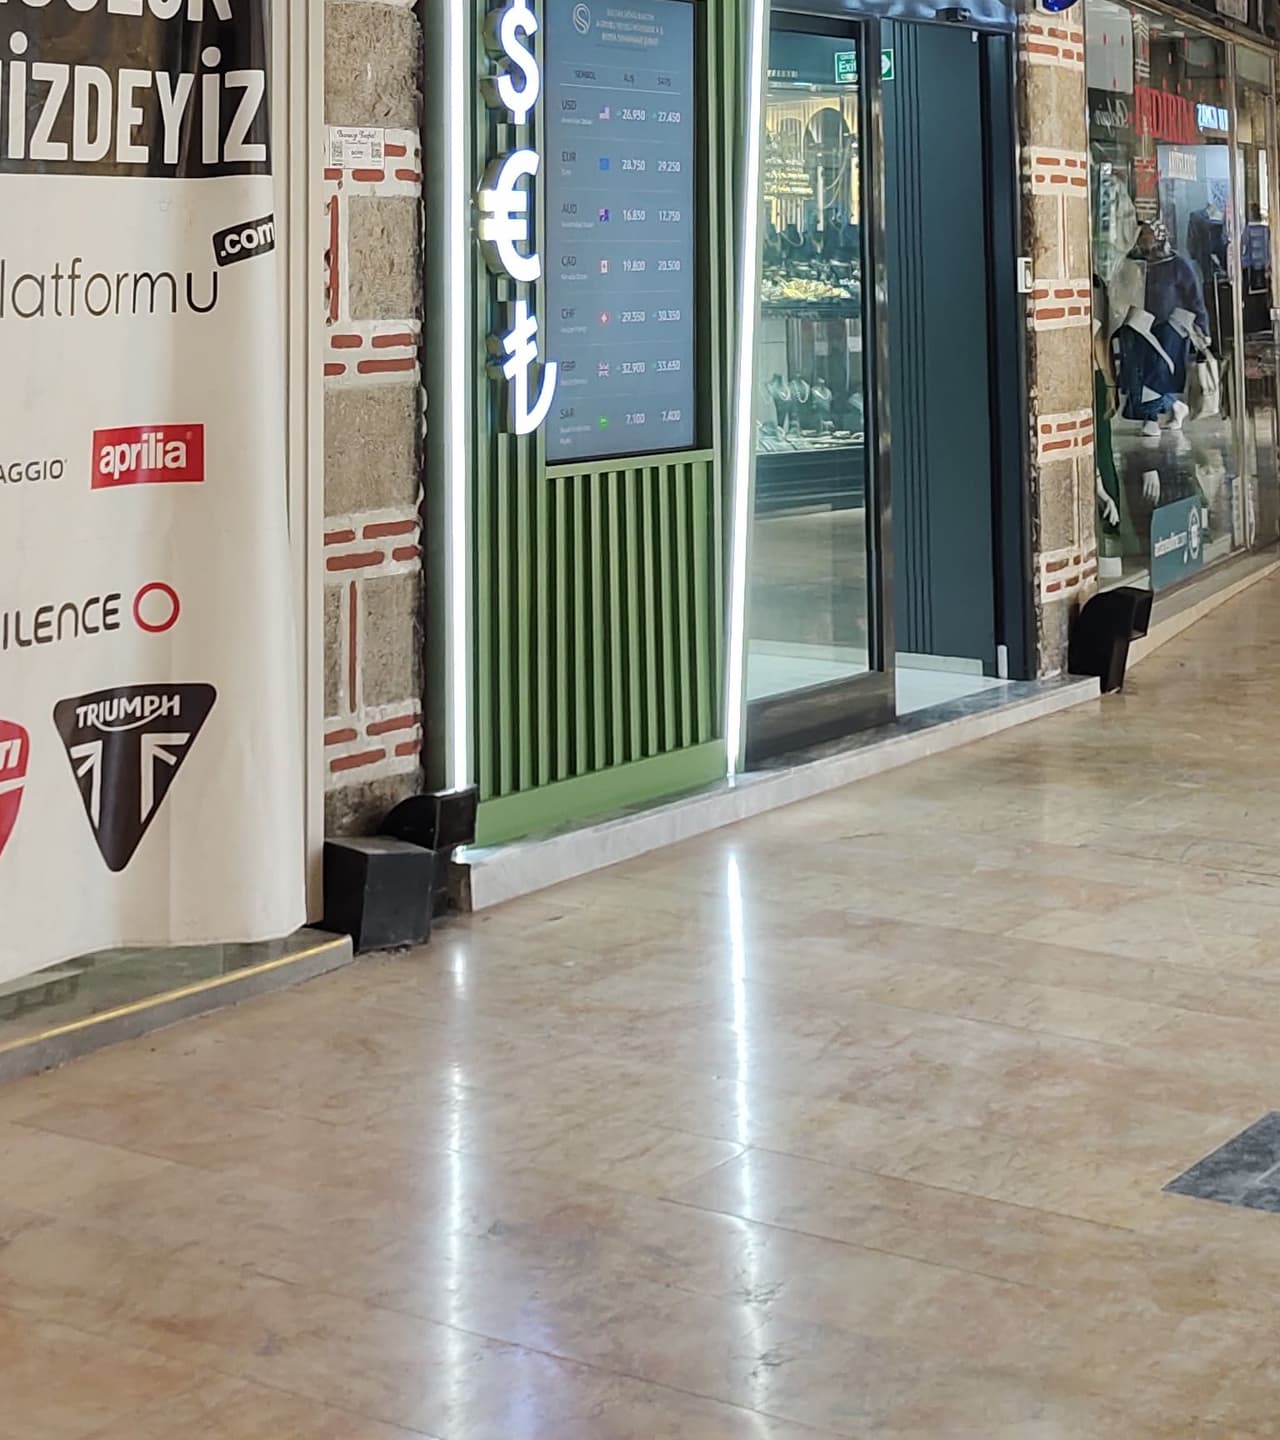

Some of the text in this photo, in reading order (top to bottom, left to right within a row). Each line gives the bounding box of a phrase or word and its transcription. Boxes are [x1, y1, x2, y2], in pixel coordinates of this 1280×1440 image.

[220, 222, 275, 257] .com
[99, 435, 188, 478] aprilia
[76, 694, 182, 733] TRIUMPH
